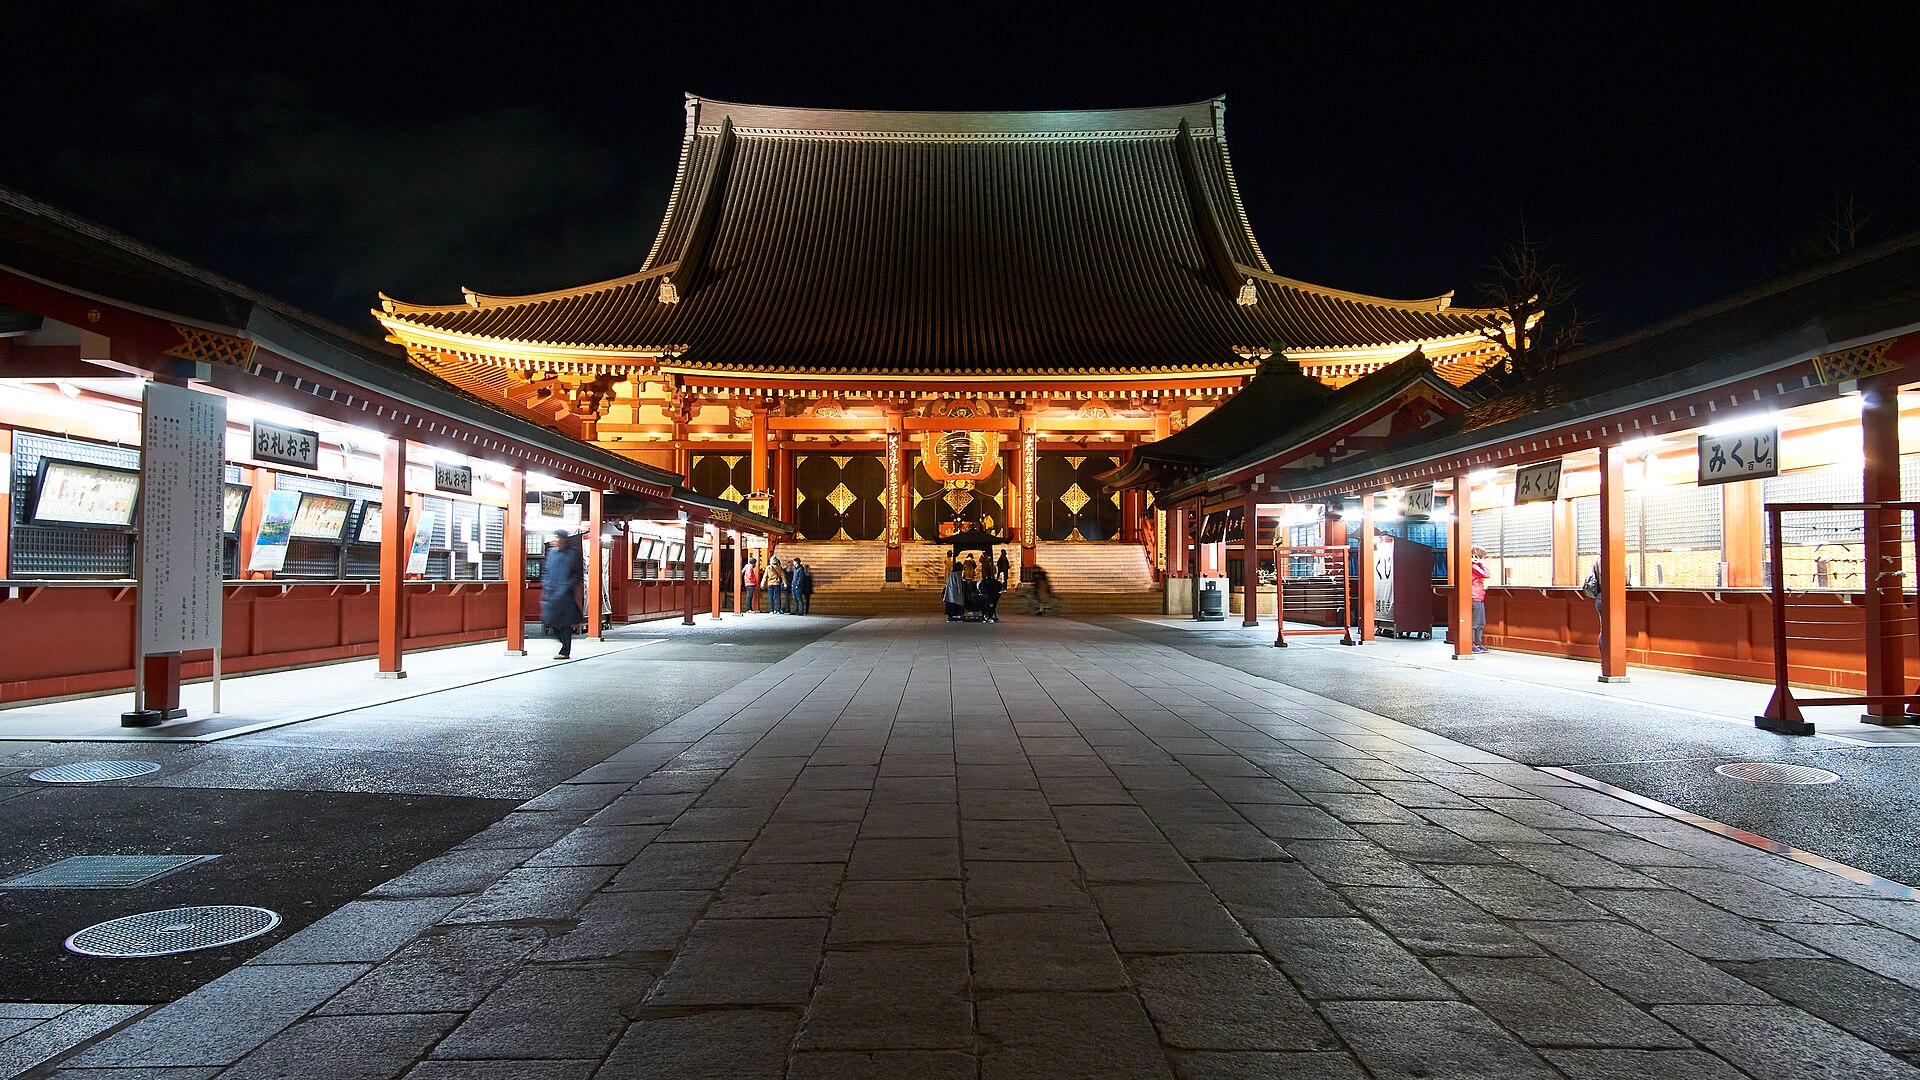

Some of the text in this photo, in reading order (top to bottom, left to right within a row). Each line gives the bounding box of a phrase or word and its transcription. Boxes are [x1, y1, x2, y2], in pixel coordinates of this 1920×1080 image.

[1709, 434, 1770, 473] みくじ
[1521, 469, 1558, 495] みくじ
